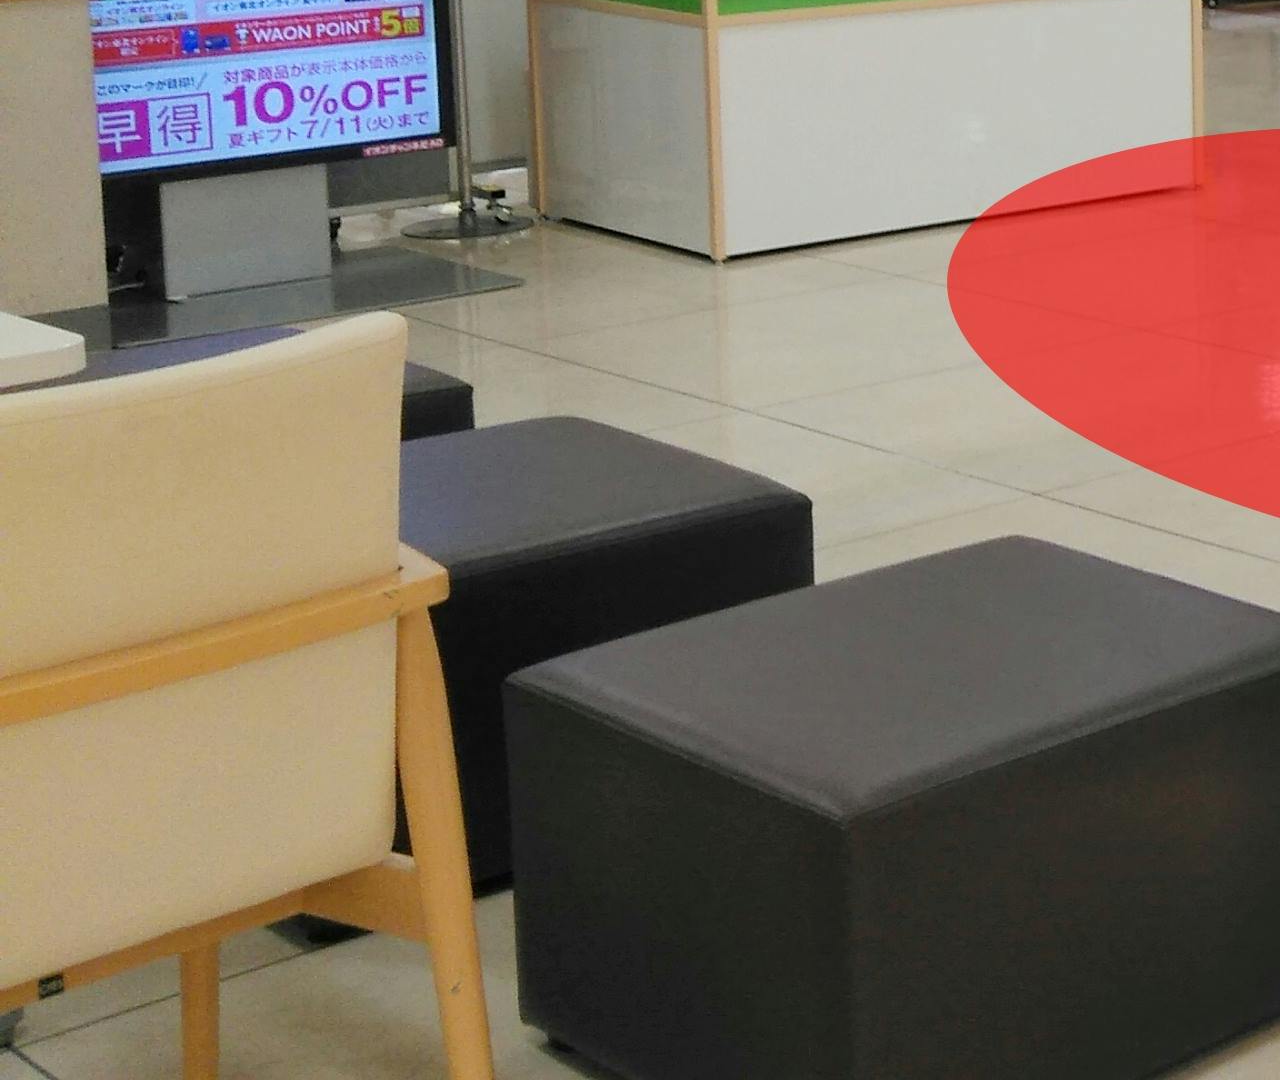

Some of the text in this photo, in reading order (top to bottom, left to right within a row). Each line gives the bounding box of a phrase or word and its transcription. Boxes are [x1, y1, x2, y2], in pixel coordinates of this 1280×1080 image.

[252, 24, 312, 44] WAON
[316, 18, 371, 38] POINT
[223, 51, 428, 86] 対象商品が表示本体価格から
[222, 74, 428, 128] 10%OFF
[97, 104, 203, 154] 早得
